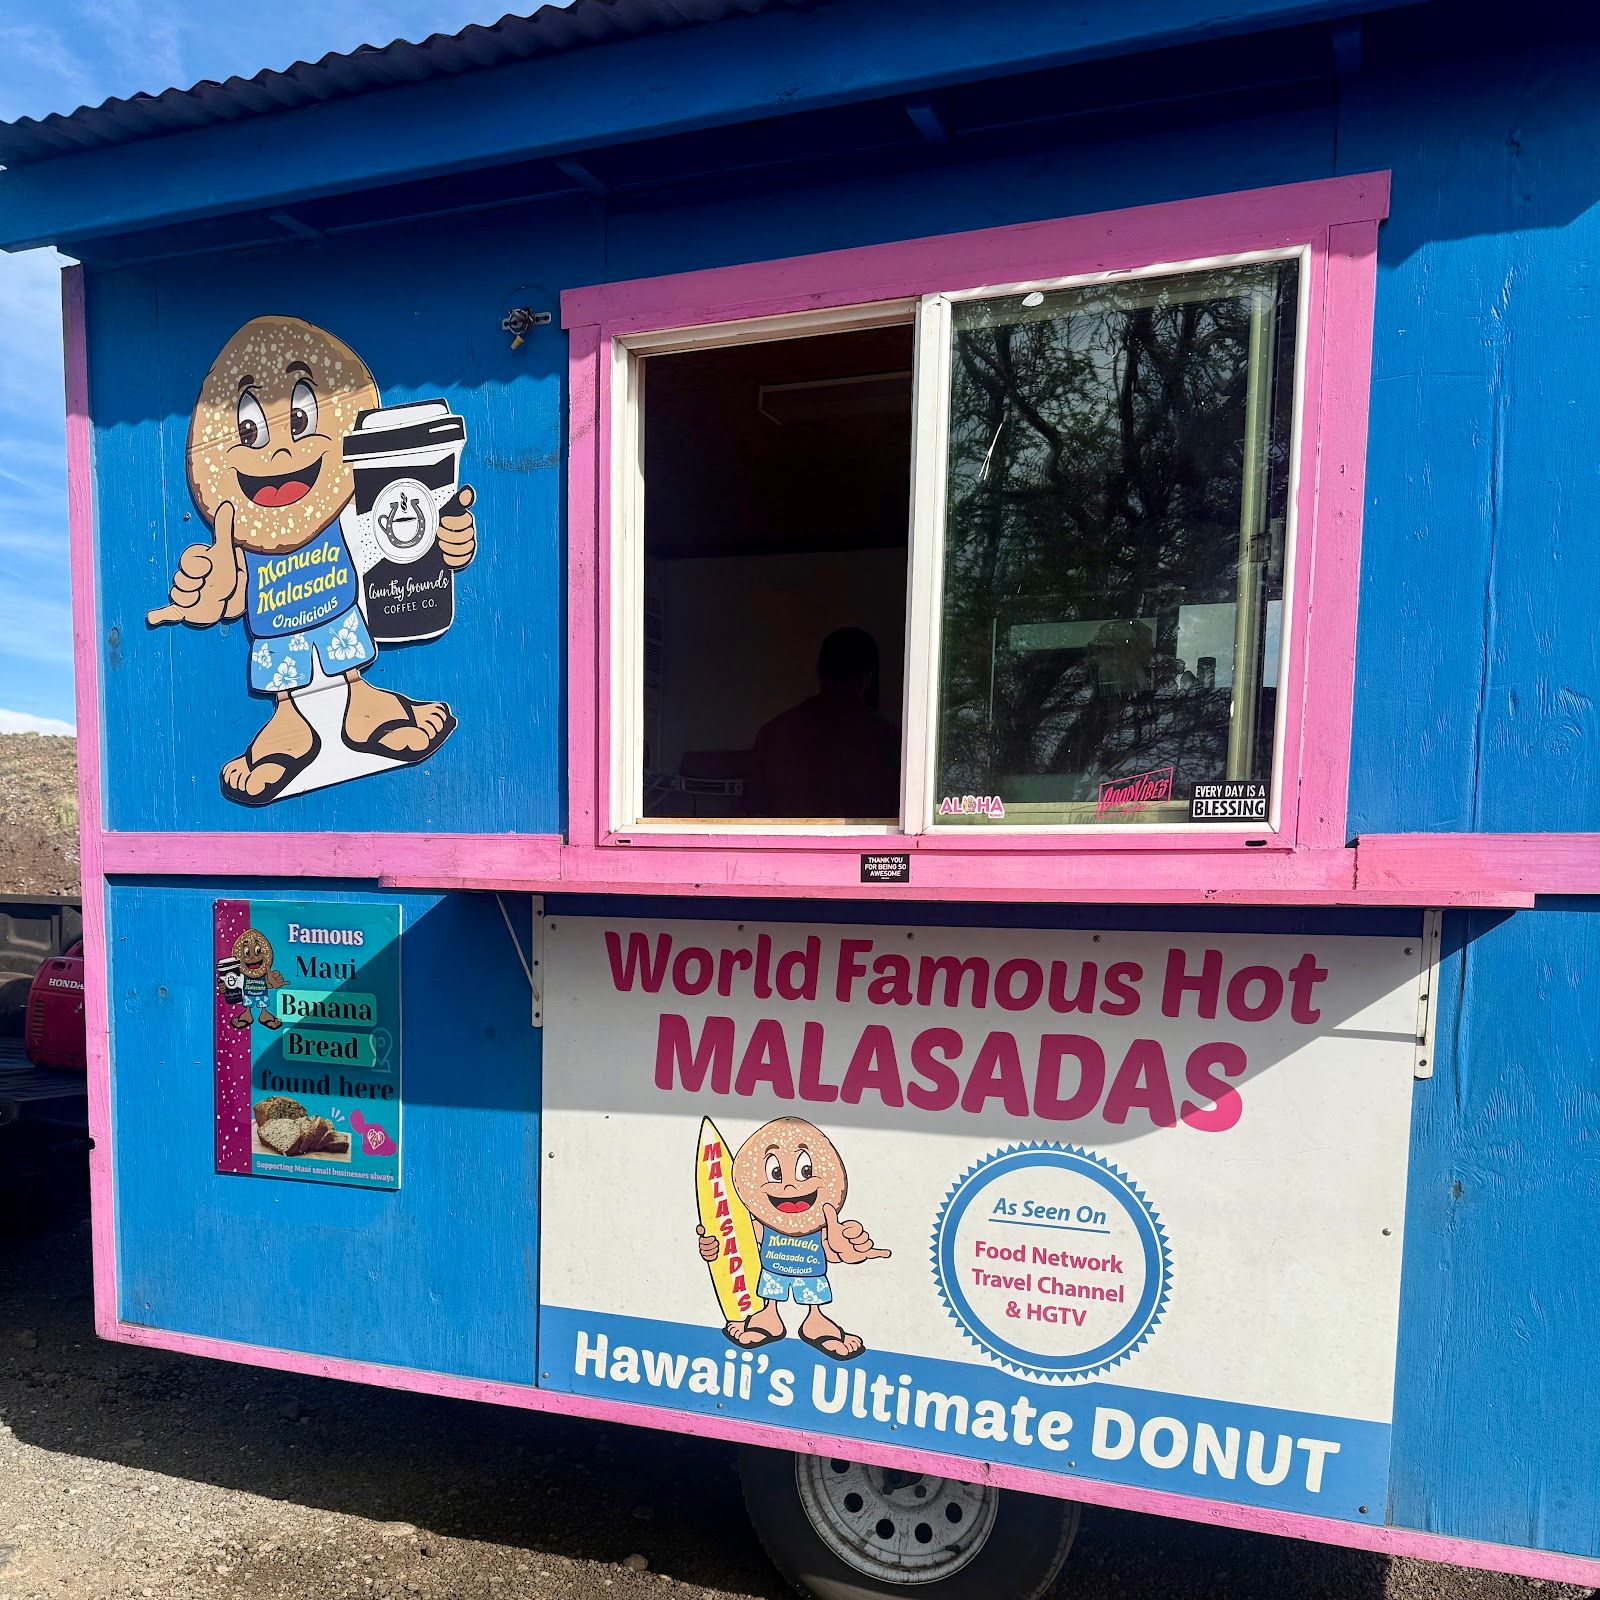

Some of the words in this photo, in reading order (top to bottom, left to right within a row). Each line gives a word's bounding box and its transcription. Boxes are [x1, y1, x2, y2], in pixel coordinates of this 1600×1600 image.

[257, 542, 340, 590] Manuela
[256, 568, 347, 614] Malasada
[369, 579, 404, 601] Country
[406, 570, 449, 597] Grounds
[272, 597, 338, 629] Onolicious
[384, 601, 417, 614] COFFEE
[422, 598, 438, 610] CO.
[1195, 785, 1222, 798] EVERY
[1225, 785, 1244, 797] DAY
[1247, 785, 1256, 797] IS
[1258, 785, 1266, 797] A
[1194, 800, 1264, 816] BLESSING
[287, 923, 364, 946] Famous
[296, 955, 356, 981] Maui
[605, 931, 821, 1001] World
[834, 939, 1144, 1014] Famous
[1161, 948, 1329, 1025] Hot
[49, 978, 84, 990] HONDA
[281, 993, 372, 1021] Banana
[288, 1032, 358, 1059] Bread
[261, 1070, 330, 1096] found
[339, 1075, 394, 1100] here
[654, 1013, 1247, 1133] MALASADAS
[256, 1161, 294, 1172] Supporting
[312, 1166, 332, 1175] small
[332, 1168, 369, 1179] businesses
[370, 1172, 394, 1182] always
[992, 1198, 1017, 1216] As
[1022, 1200, 1070, 1221] Seen
[1076, 1205, 1107, 1225] On
[703, 1142, 751, 1312] MALASADAS
[768, 1235, 820, 1252] Manuela
[975, 1240, 1026, 1262] Food
[1032, 1246, 1124, 1274] Network
[765, 1250, 805, 1264] Malasada
[806, 1255, 821, 1265] Co.
[772, 1262, 813, 1275] Onolicious
[972, 1268, 1031, 1292] Travel
[1037, 1276, 1125, 1303] Channel
[1005, 1301, 1021, 1319] &
[1027, 1303, 1087, 1327] HGTV
[574, 1330, 795, 1407] Hawaii’s
[811, 1360, 1071, 1452] Ultimate
[1091, 1407, 1341, 1493] DONUT
